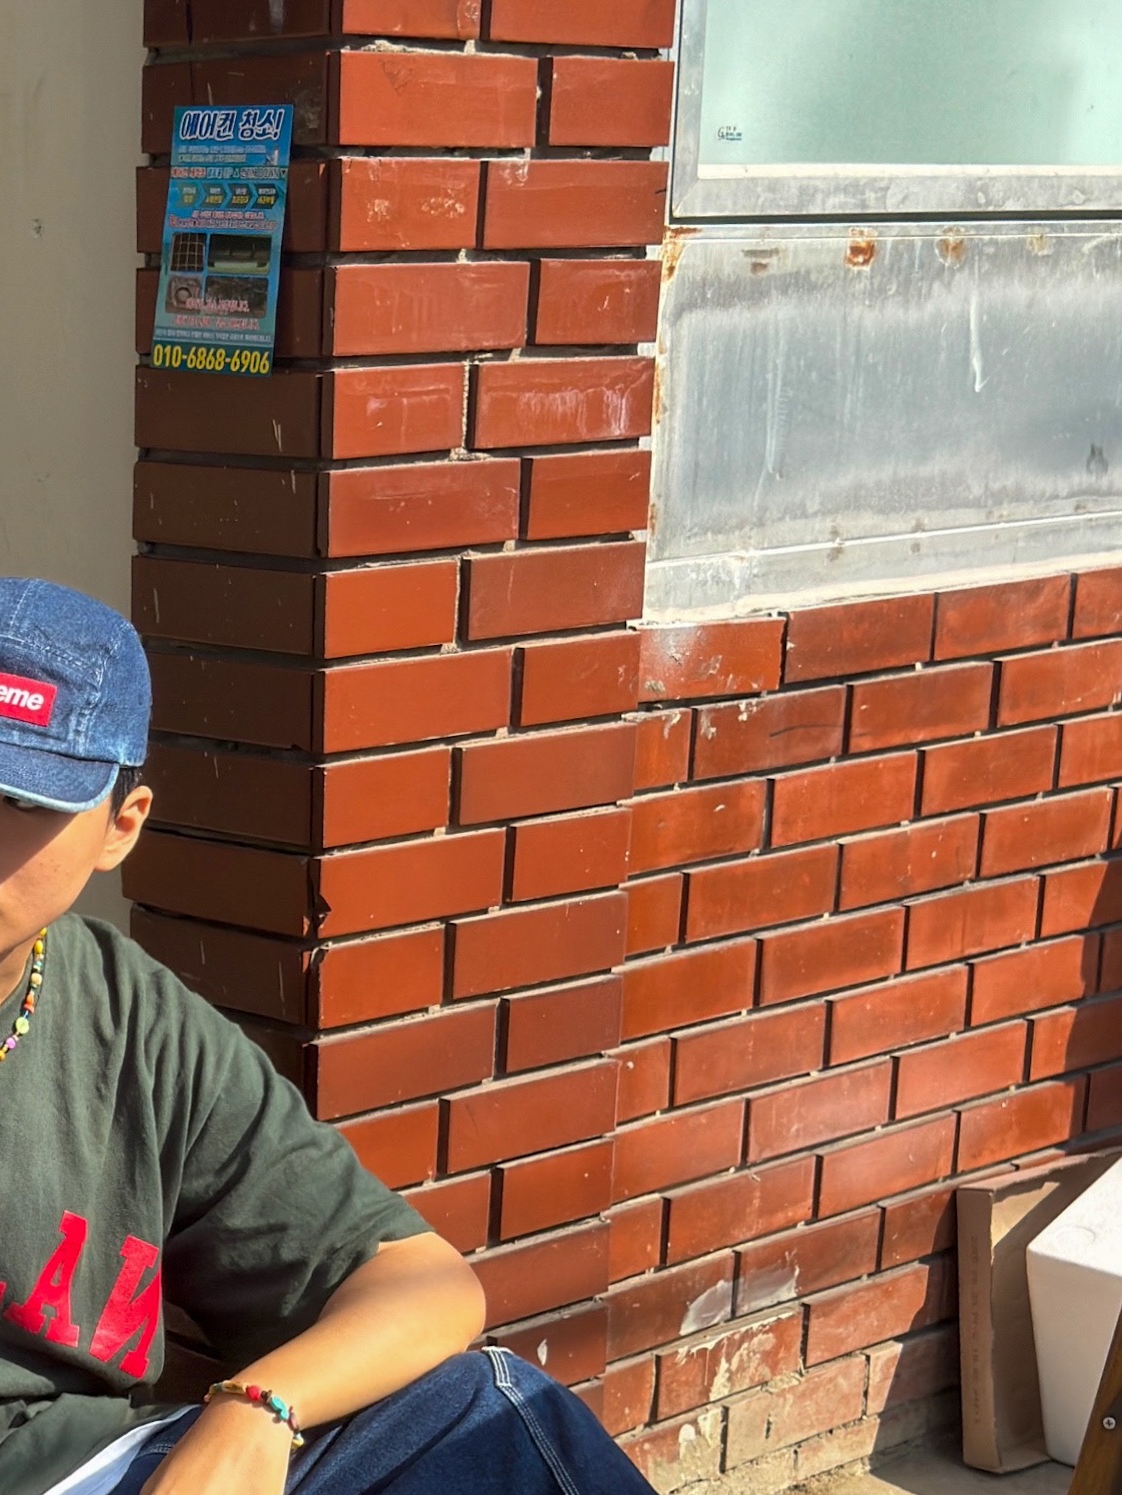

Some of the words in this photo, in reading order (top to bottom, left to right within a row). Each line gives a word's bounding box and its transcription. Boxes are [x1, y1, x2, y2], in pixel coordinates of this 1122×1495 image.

[180, 110, 237, 140] 에어컨
[239, 109, 284, 140] 청소!
[153, 344, 270, 374] 010-6868-6906
